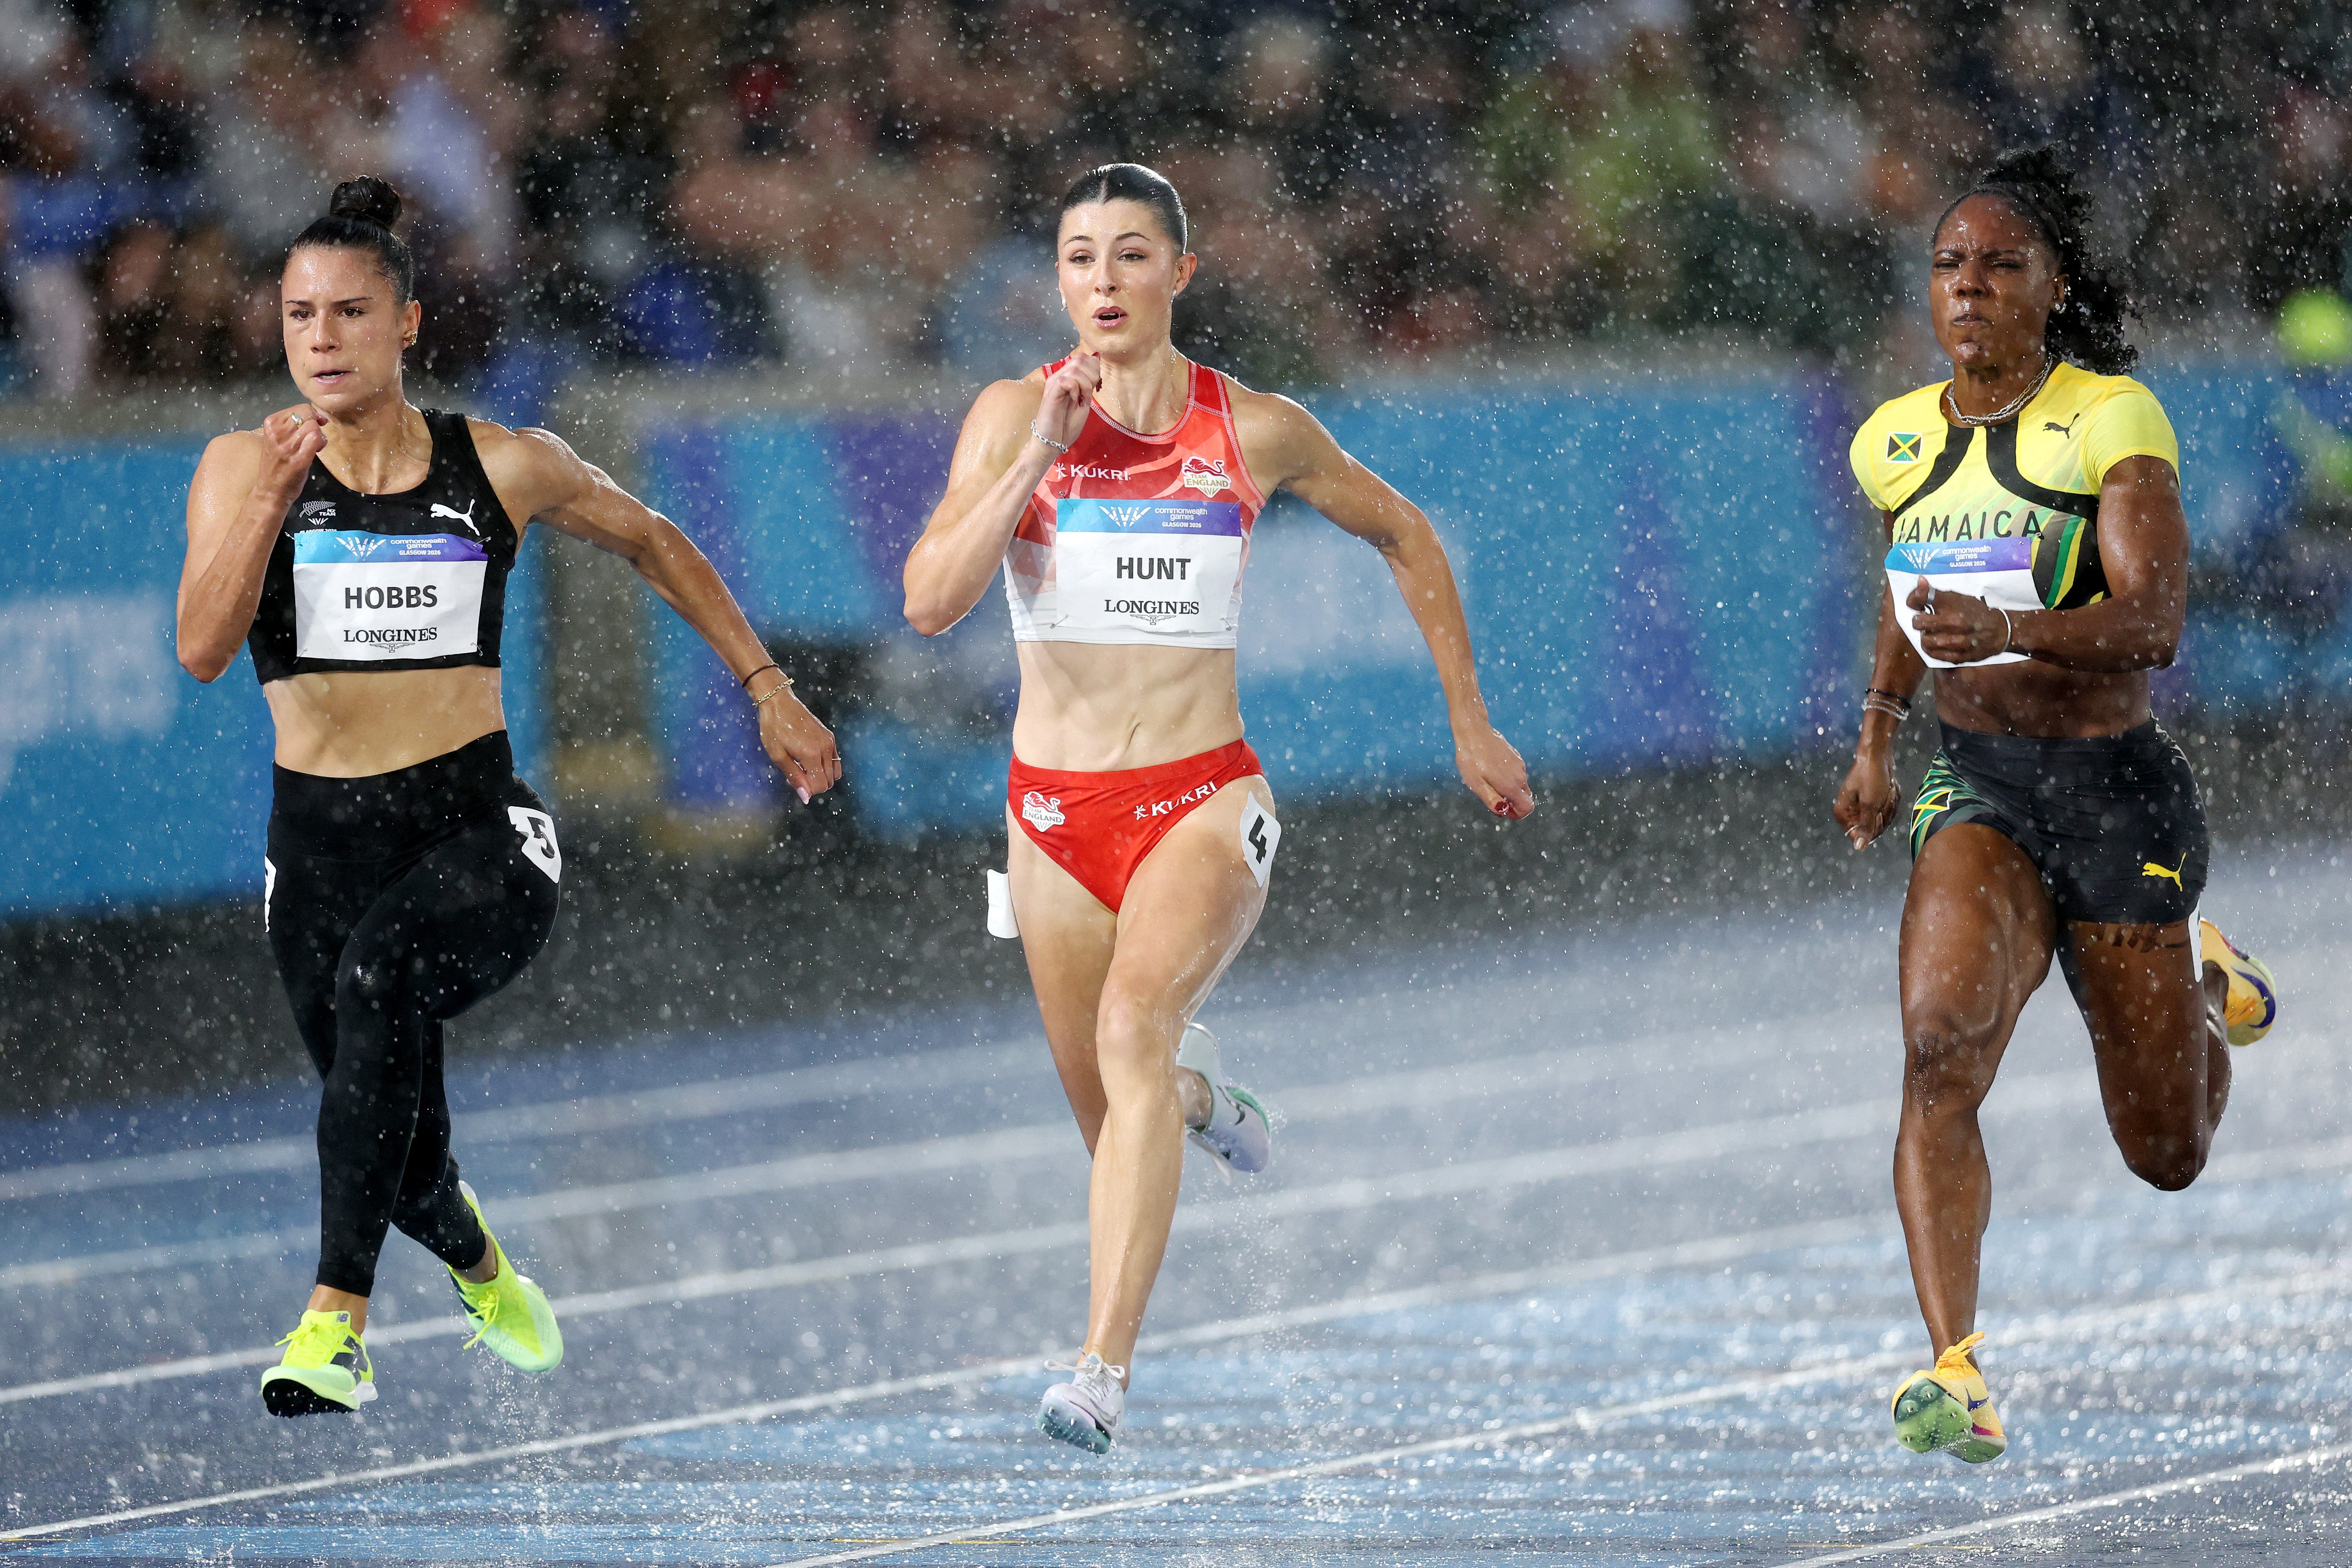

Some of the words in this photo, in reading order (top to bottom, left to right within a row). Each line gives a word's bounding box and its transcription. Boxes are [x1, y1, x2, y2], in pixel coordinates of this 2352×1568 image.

[1070, 464, 1129, 481] KUKRI
[1186, 478, 1229, 487] ENGLAND
[1943, 545, 1991, 555] commonwealth
[1955, 553, 1978, 561] games
[1116, 557, 1191, 580] HUNT
[345, 585, 438, 609] HOBBS
[1104, 599, 1199, 615] LONGINES
[343, 627, 438, 643] LONGINES
[1151, 781, 1217, 816] KUKRI
[1024, 810, 1062, 823] ENGLAND
[527, 816, 555, 859] 5
[1248, 814, 1267, 864] 4
